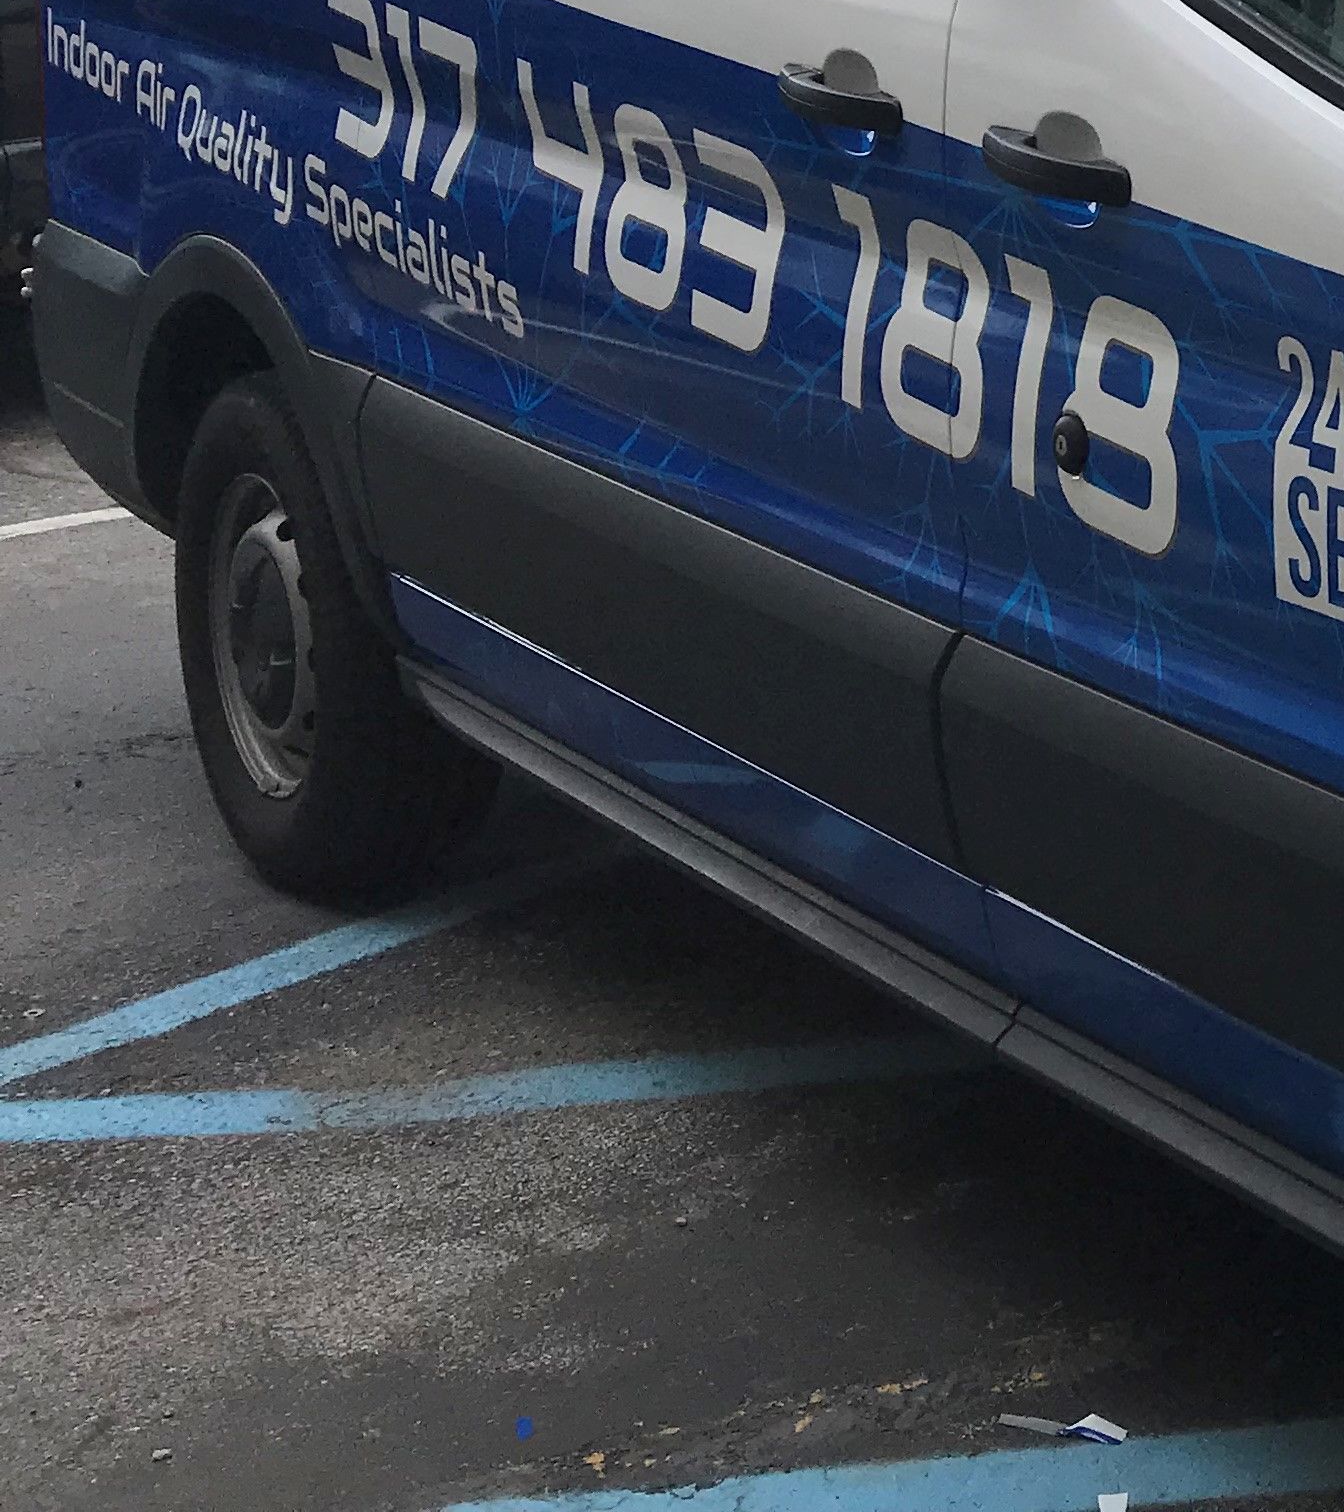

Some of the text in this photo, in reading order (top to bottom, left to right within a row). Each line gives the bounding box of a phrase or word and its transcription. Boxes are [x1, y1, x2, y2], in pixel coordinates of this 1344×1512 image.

[46, 7, 525, 338] Indoor Air Quality Specialists
[516, 58, 785, 355] 483
[831, 183, 1180, 559] 1818
